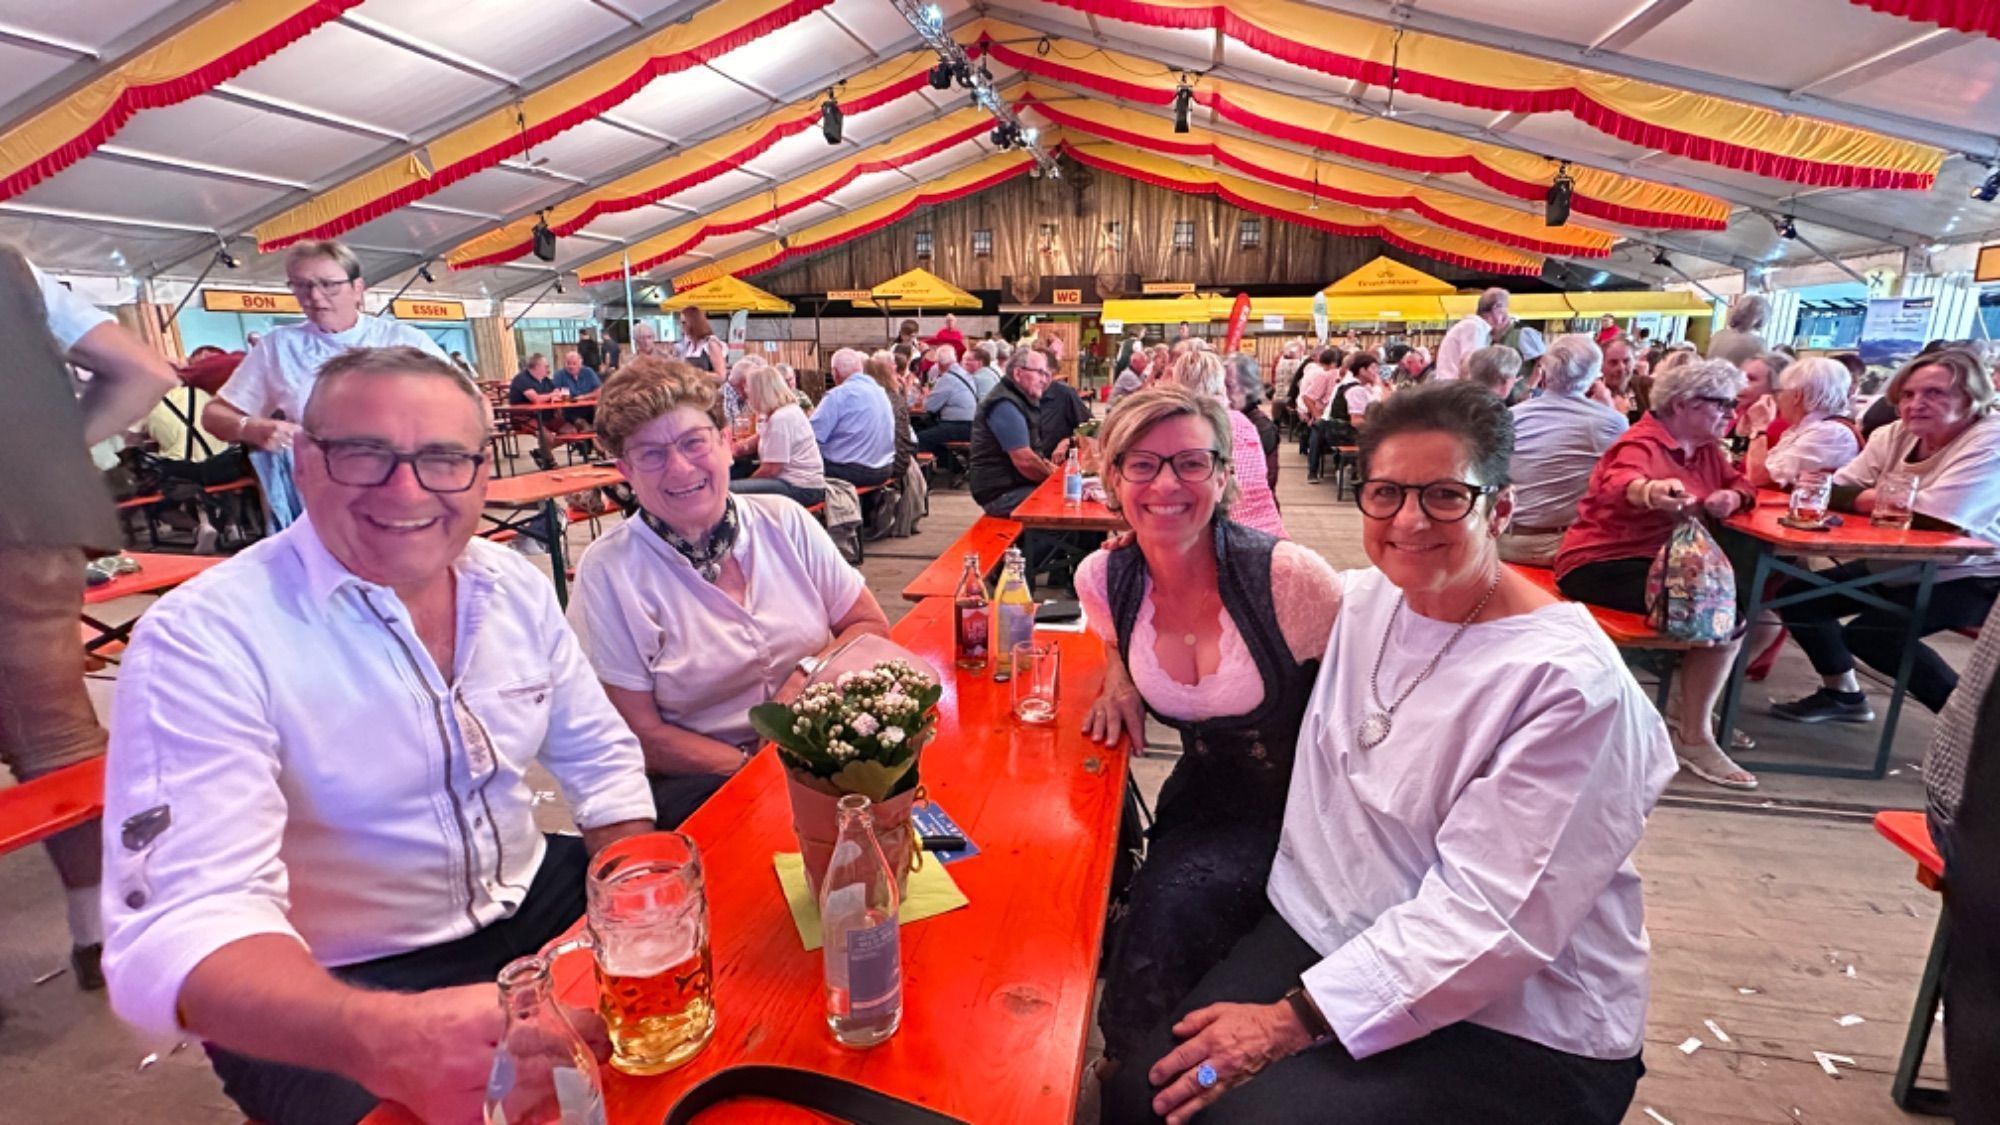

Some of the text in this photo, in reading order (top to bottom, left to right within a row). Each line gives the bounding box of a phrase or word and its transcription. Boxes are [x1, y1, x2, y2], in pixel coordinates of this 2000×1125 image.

[242, 295, 276, 309] BON
[1057, 291, 1078, 302] WC
[413, 304, 447, 316] ESSEN
